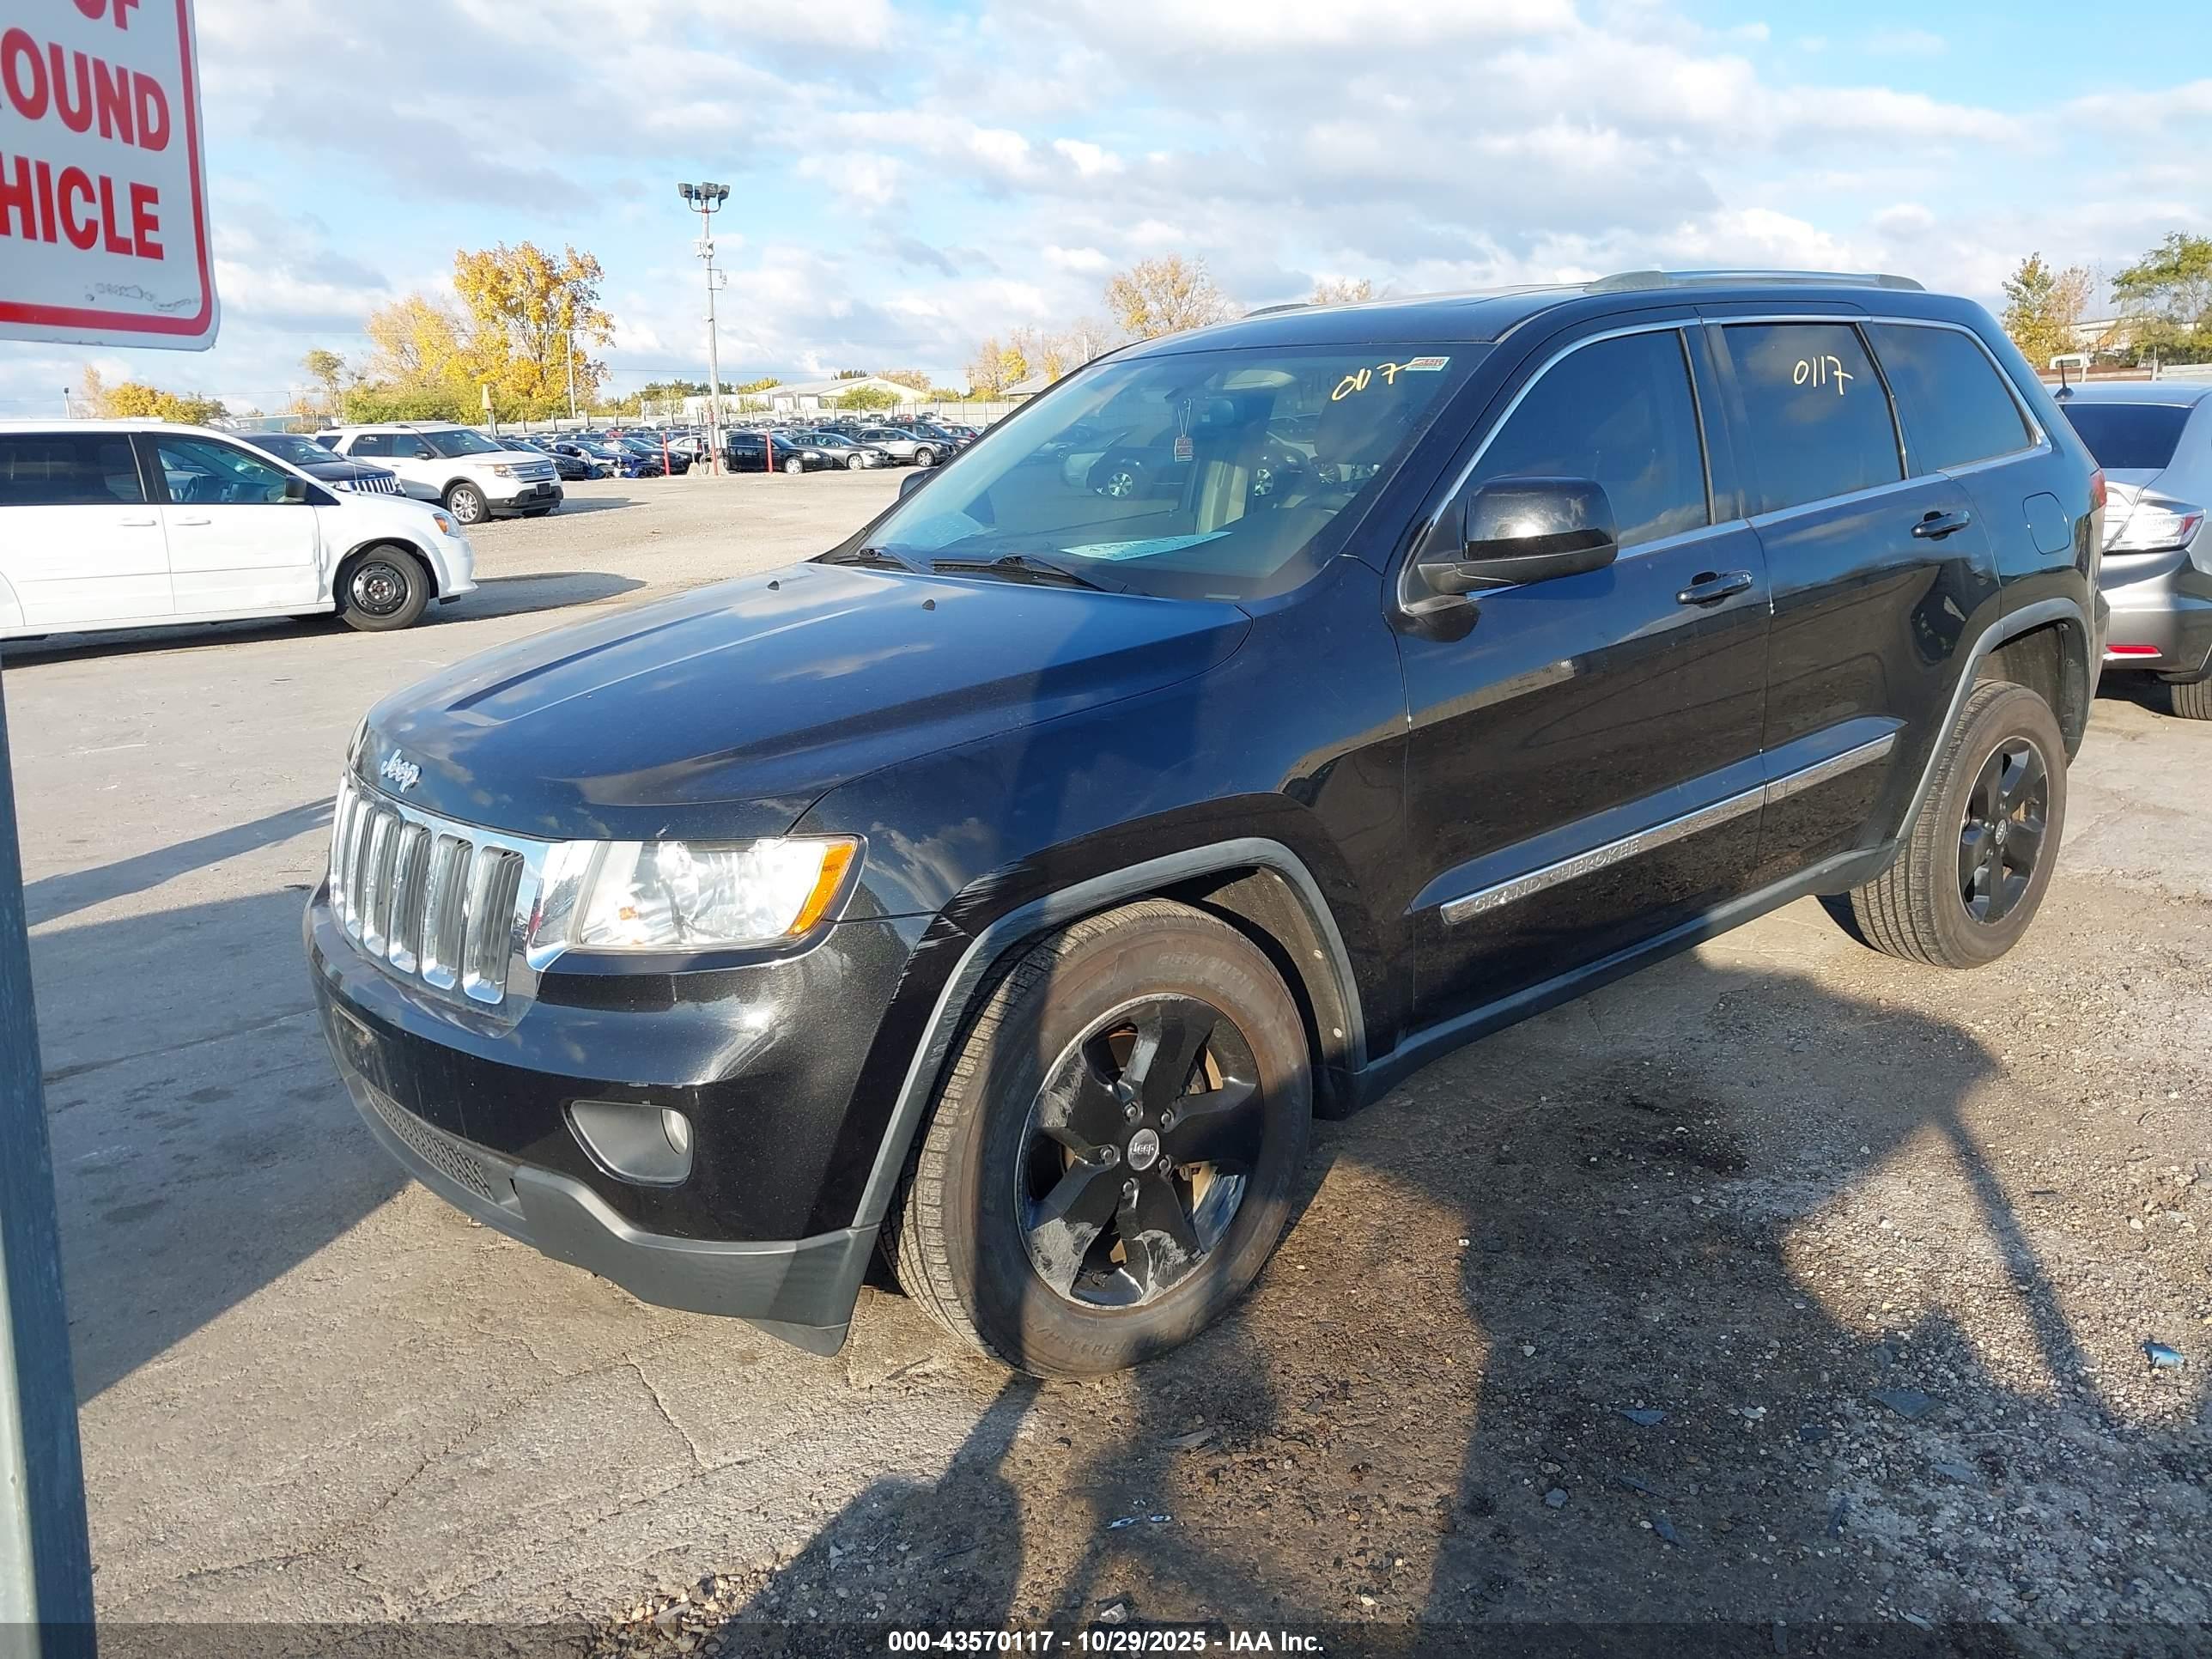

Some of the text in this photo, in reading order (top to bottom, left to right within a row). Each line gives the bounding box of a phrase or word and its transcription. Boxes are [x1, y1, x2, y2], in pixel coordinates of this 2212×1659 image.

[0, 27, 170, 152] OUND
[1793, 355, 1854, 395] 0117
[380, 749, 420, 793] Jeep
[1474, 839, 1639, 912] GRAND CHEROKEE
[1130, 1142, 1155, 1156] Jeep
